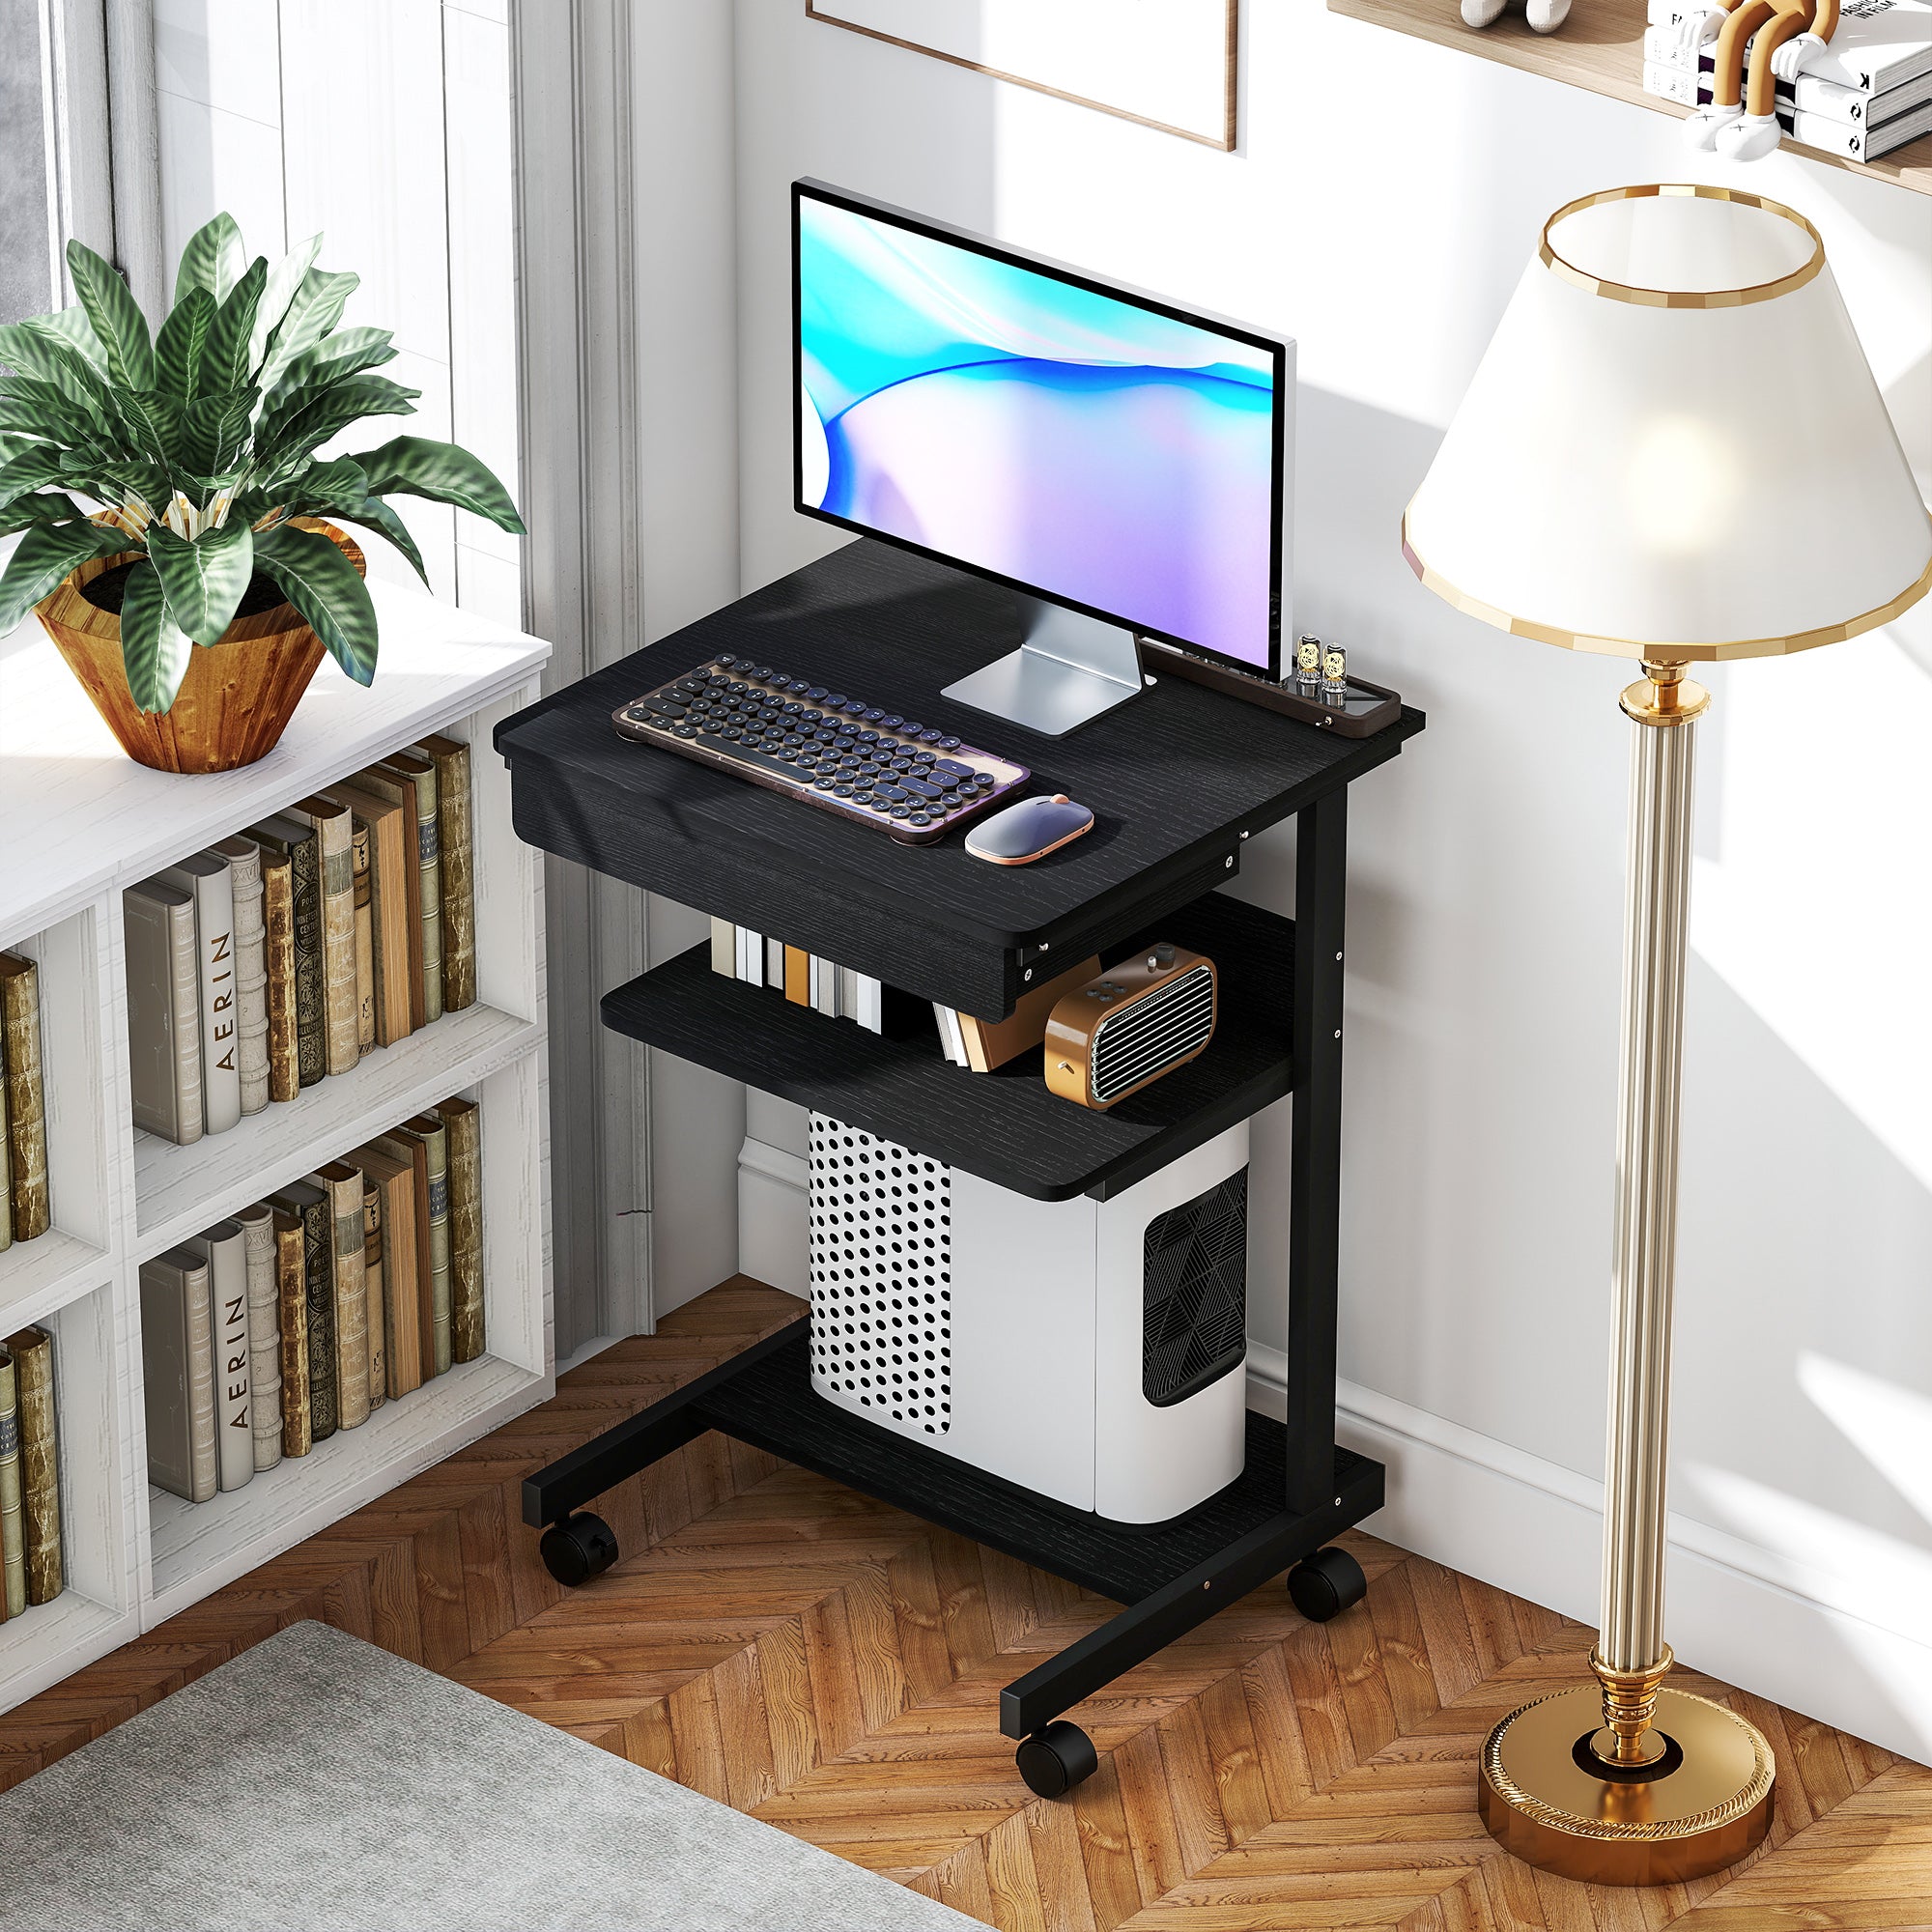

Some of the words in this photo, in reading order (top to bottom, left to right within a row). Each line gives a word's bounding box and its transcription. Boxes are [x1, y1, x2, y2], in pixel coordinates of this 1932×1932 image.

[1866, 0, 1897, 14] FILM
[211, 931, 235, 1071] AERIN
[225, 1294, 248, 1430] AERIN
